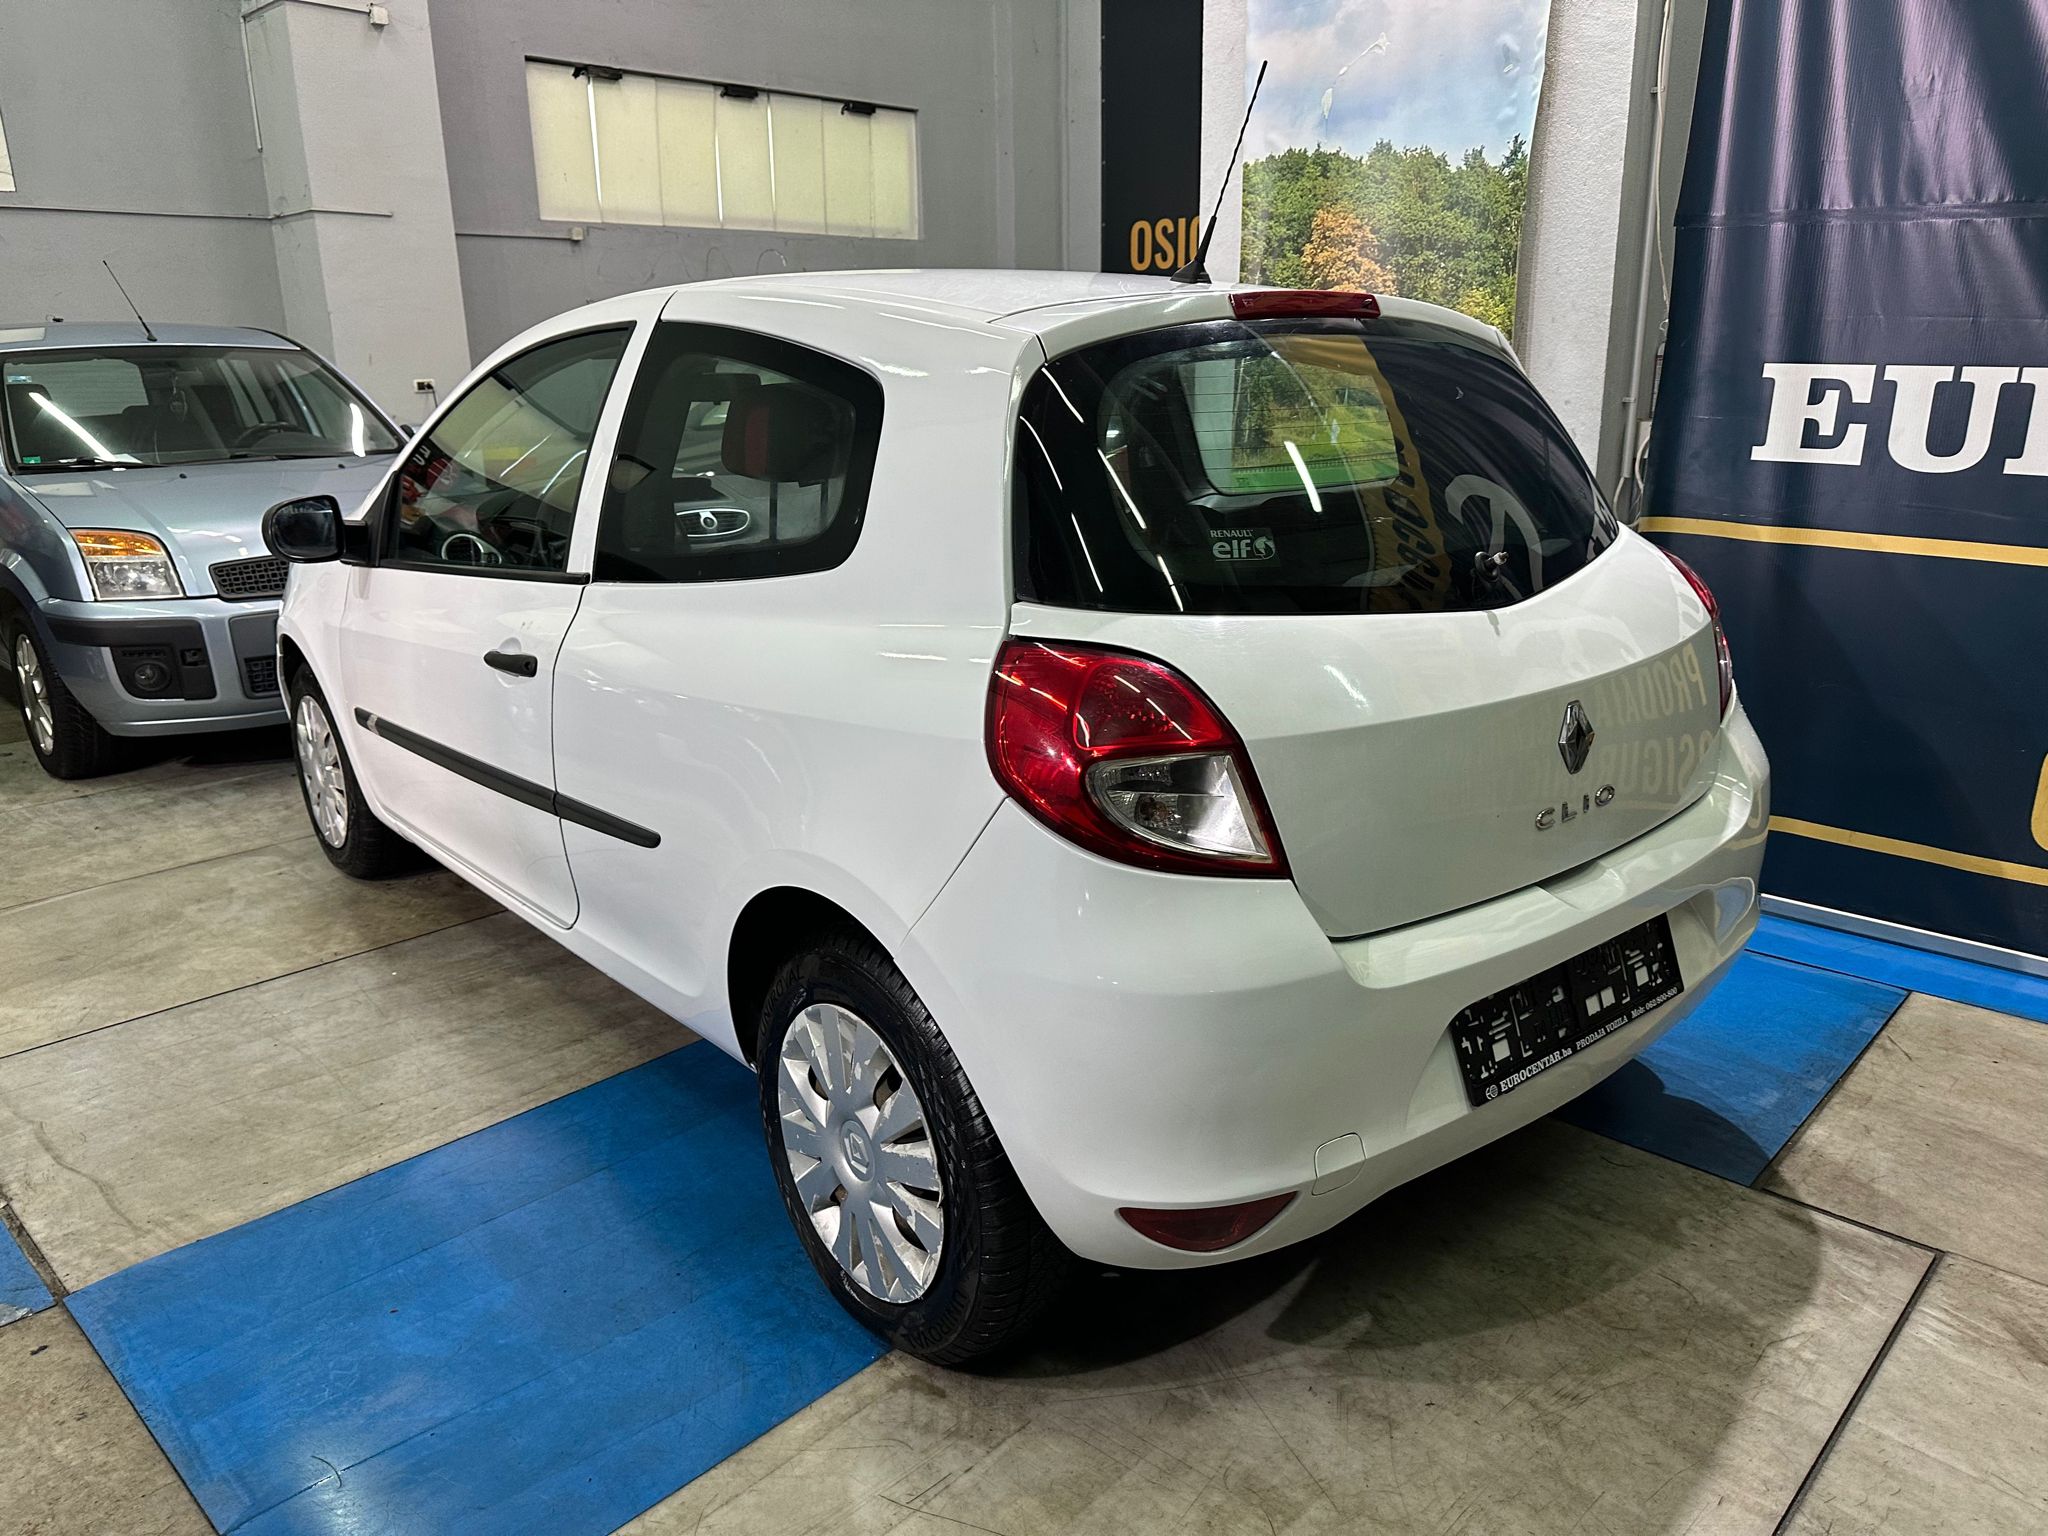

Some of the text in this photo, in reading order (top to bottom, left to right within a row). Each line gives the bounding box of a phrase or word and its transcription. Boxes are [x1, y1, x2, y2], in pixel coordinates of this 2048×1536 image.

[1210, 529, 1254, 538] RENAULT
[1212, 539, 1252, 559] elf
[1535, 784, 1616, 831] CLIO
[1500, 1047, 1573, 1093] EUROCENTAR.ba
[1575, 1027, 1607, 1050] PRODAJA
